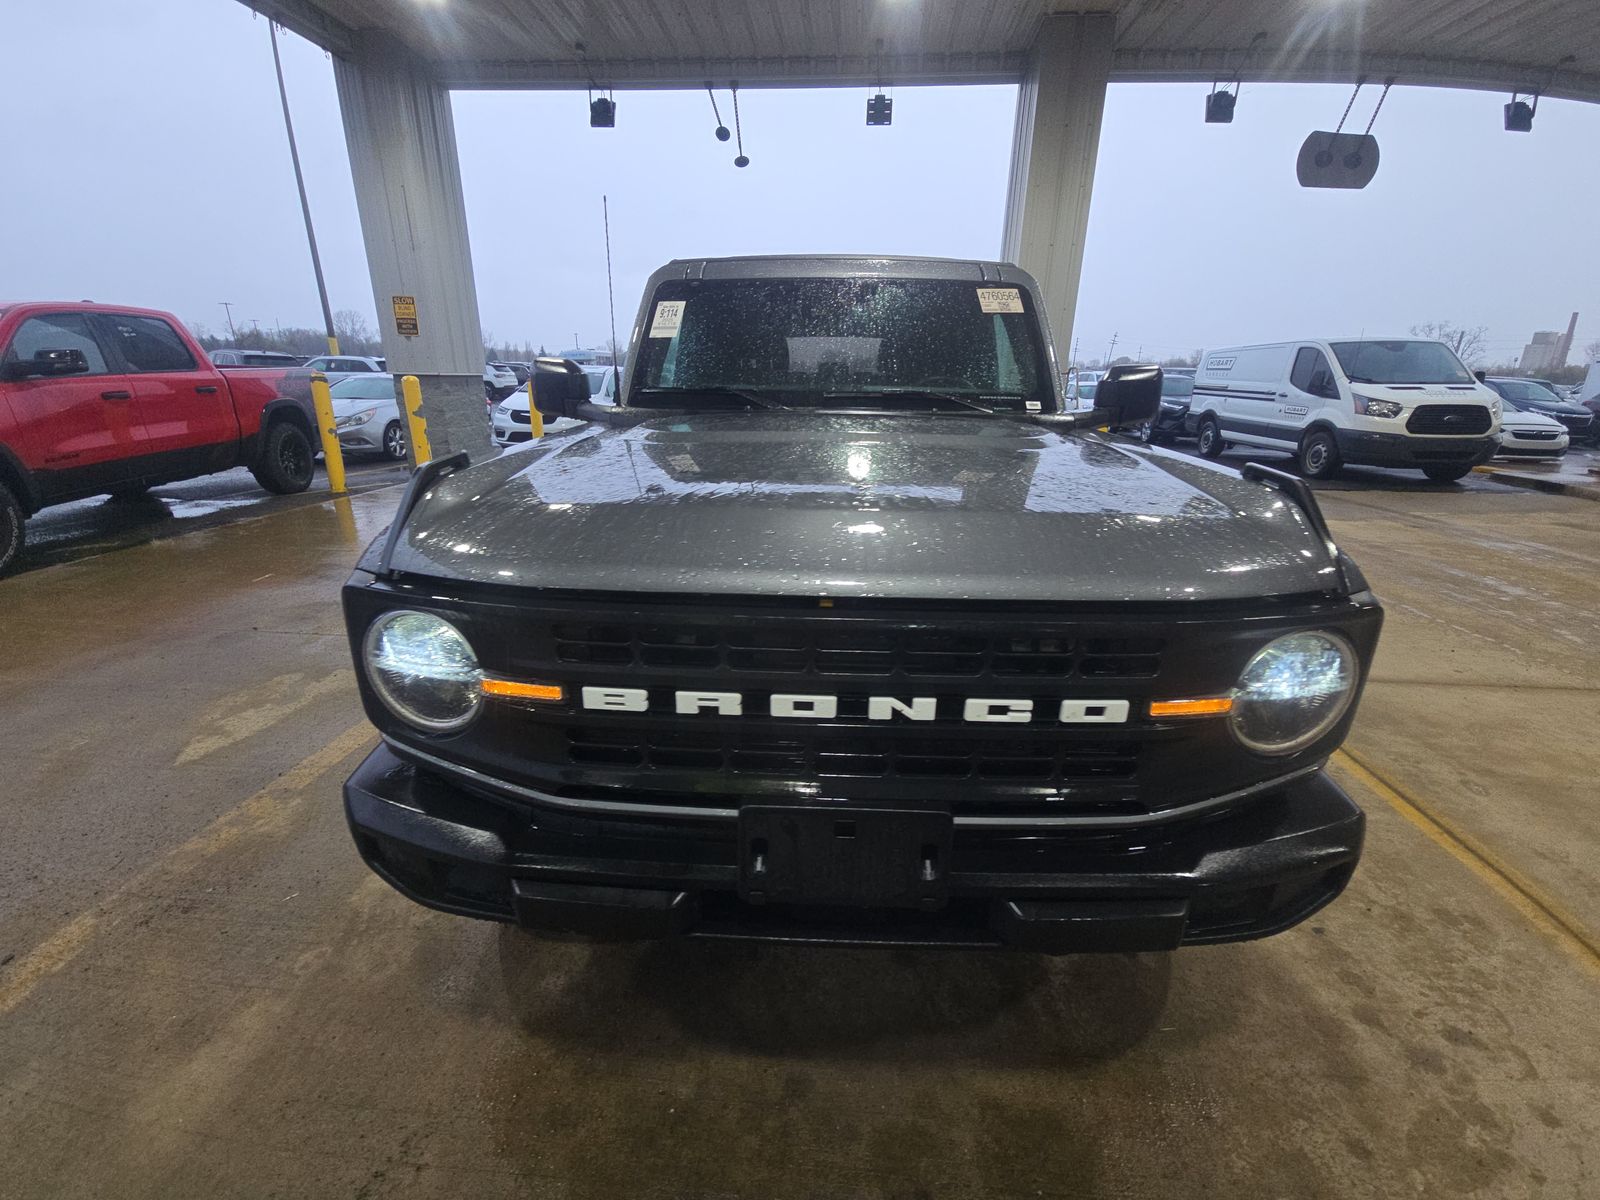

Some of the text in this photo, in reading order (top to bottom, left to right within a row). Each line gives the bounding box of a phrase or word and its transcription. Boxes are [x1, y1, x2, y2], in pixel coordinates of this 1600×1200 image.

[980, 291, 1019, 301] 4760564
[1209, 359, 1233, 367] HOBART
[582, 686, 1130, 724] BRONCO
